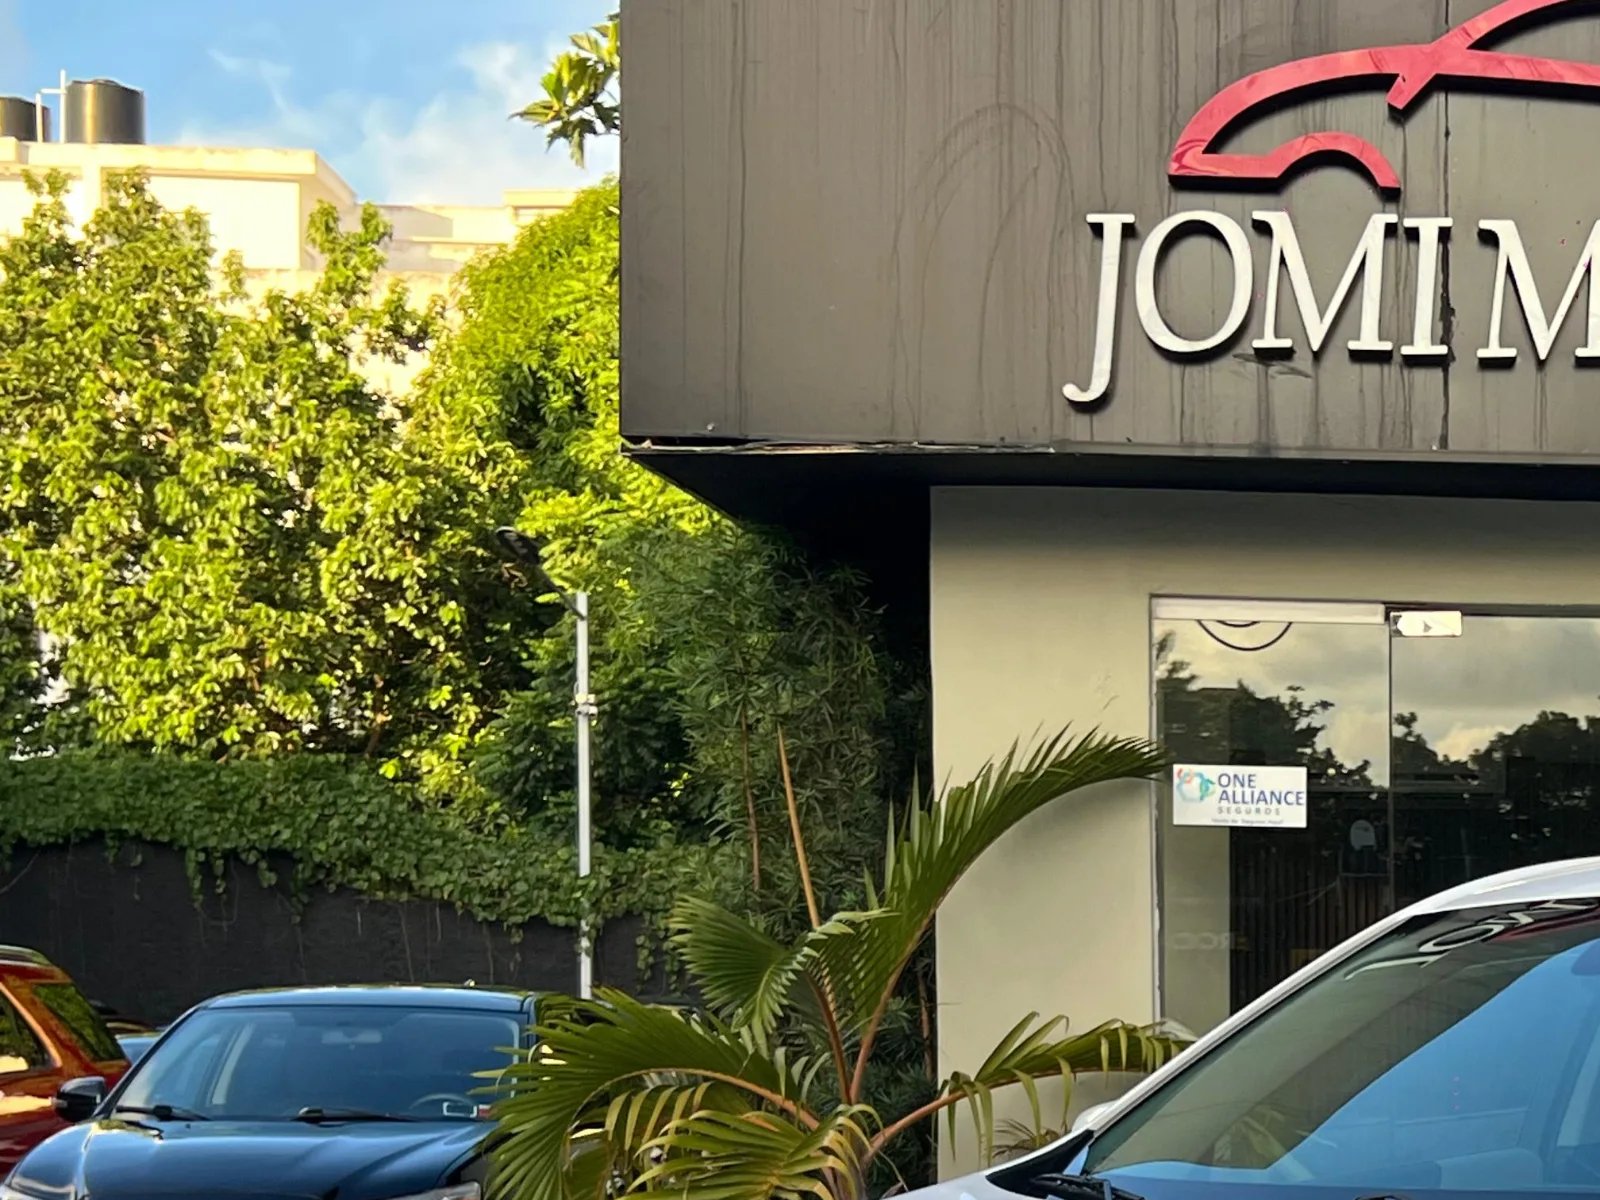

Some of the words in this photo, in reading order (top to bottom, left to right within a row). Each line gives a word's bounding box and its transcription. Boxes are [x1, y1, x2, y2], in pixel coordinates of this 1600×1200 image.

[1062, 210, 1453, 402] JOMI
[1217, 773, 1257, 788] ONE
[1218, 790, 1305, 806] ALLIANCE
[1217, 806, 1281, 816] SEGUROS
